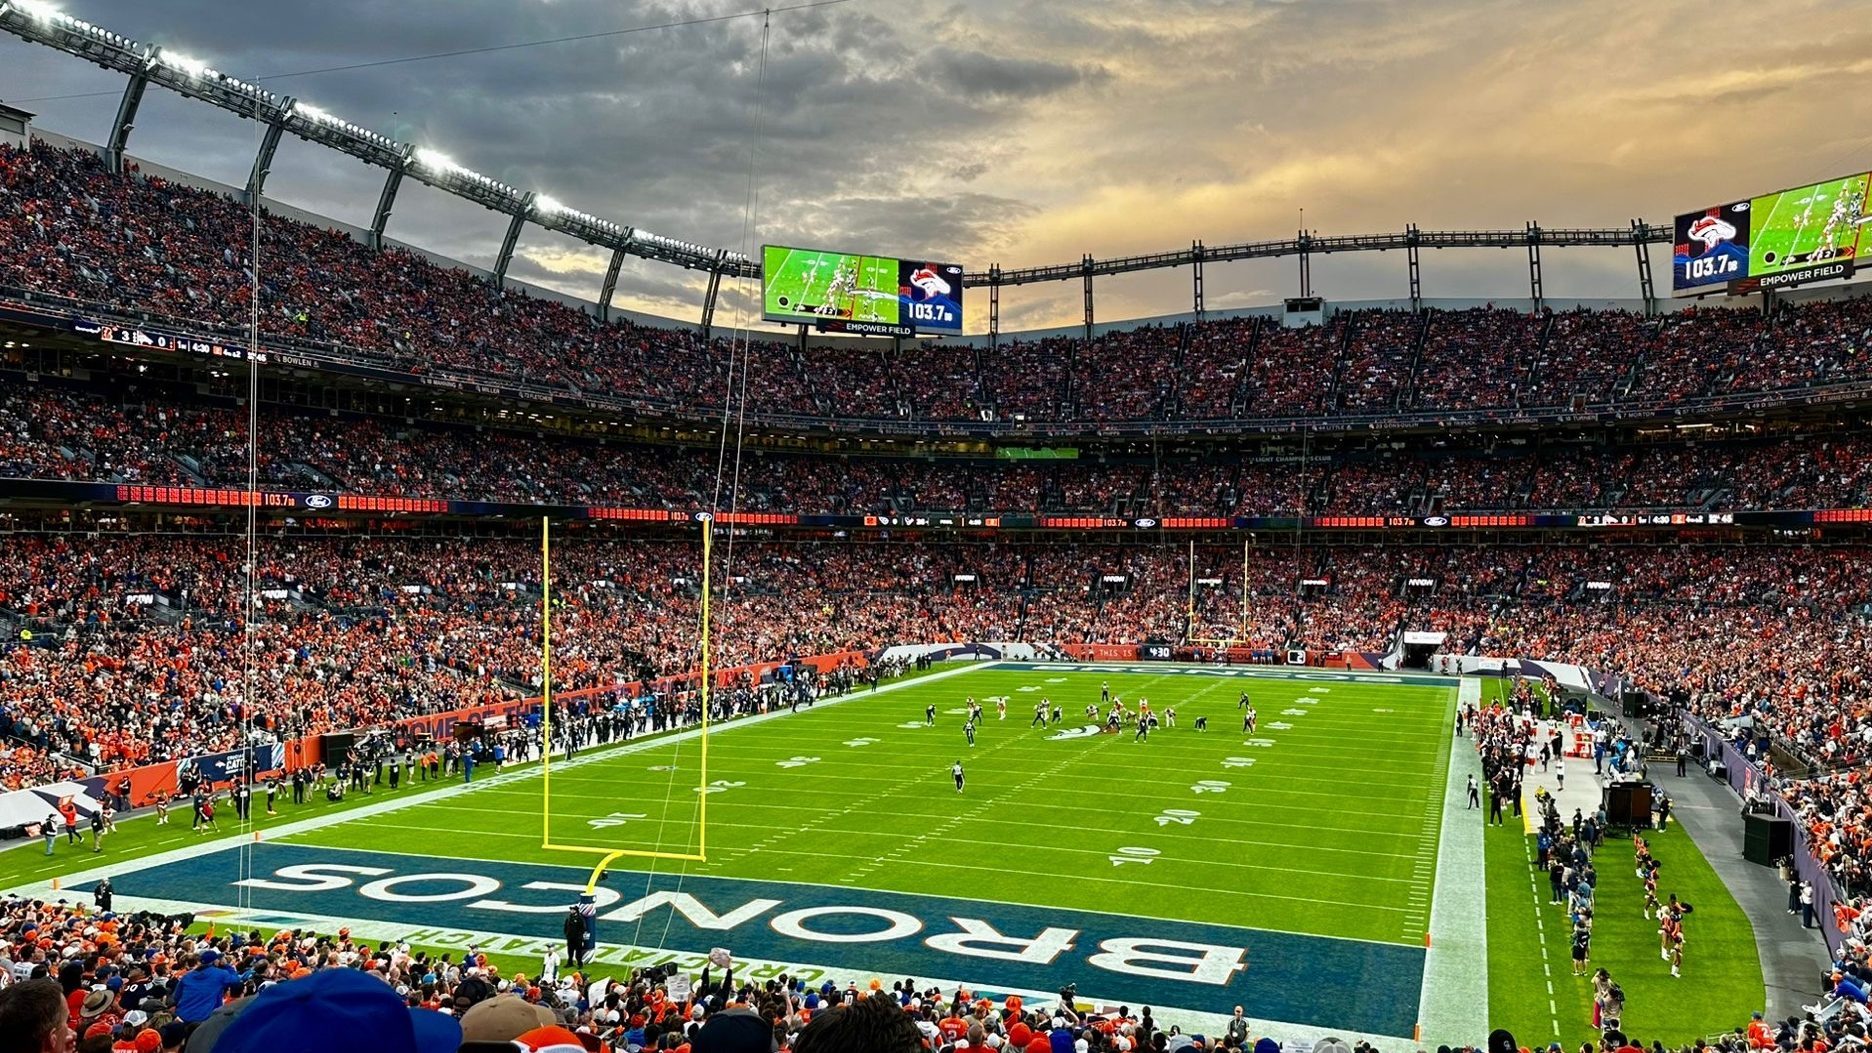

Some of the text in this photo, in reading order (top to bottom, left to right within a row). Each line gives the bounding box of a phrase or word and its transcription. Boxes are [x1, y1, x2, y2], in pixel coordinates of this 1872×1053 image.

[1685, 254, 1728, 280] 103.7
[1760, 264, 1844, 286] EMPOWER FIELD
[908, 302, 945, 321] 103.7
[846, 322, 911, 335] EMPOWER FIELD
[121, 330, 130, 341] 3
[158, 336, 166, 347] 0
[192, 342, 210, 353] 4:30
[282, 355, 312, 367] BOWLEN
[1255, 455, 1274, 463] LIGHT
[1275, 455, 1314, 463] CHAMPIS
[264, 493, 289, 506] 103.7
[307, 496, 329, 507] Ford
[1103, 518, 1122, 527] 103.7
[1388, 517, 1409, 526] 103.7
[1621, 515, 1628, 525] 0
[1652, 515, 1670, 524] 4:30
[1099, 649, 1132, 657] THIS IS
[1149, 647, 1170, 658] 4:30
[587, 811, 648, 827] 10
[1153, 808, 1201, 824] 20
[1108, 846, 1162, 863] 10
[230, 863, 1249, 985] BRONCOS
[844, 994, 854, 1006] 10
